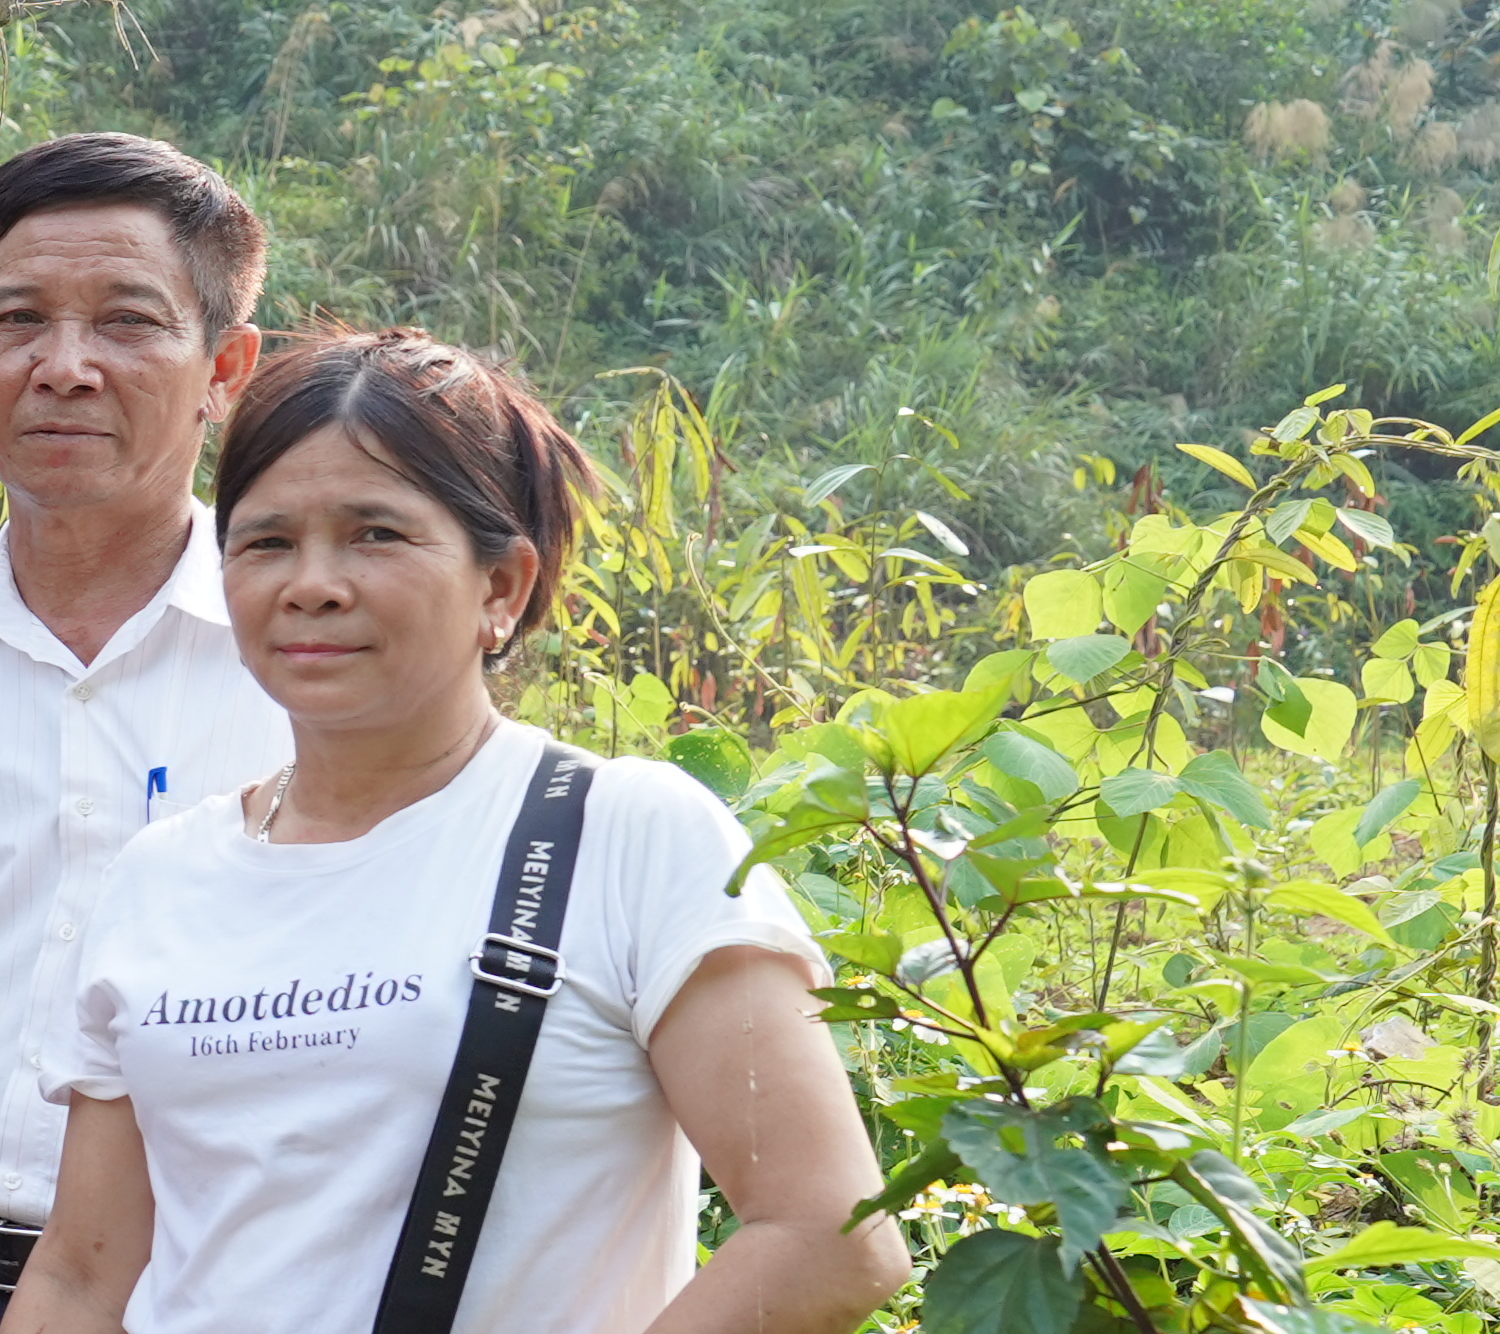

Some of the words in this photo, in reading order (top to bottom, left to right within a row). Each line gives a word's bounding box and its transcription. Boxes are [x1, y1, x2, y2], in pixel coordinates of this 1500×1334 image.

[509, 840, 555, 942] MEIYINA
[140, 971, 424, 1026] Amotdedios
[495, 950, 533, 1013] MN
[190, 1034, 239, 1057] 16th
[249, 1027, 361, 1054] February
[442, 1072, 501, 1197] MEIYINA
[420, 1210, 462, 1279] MYN
